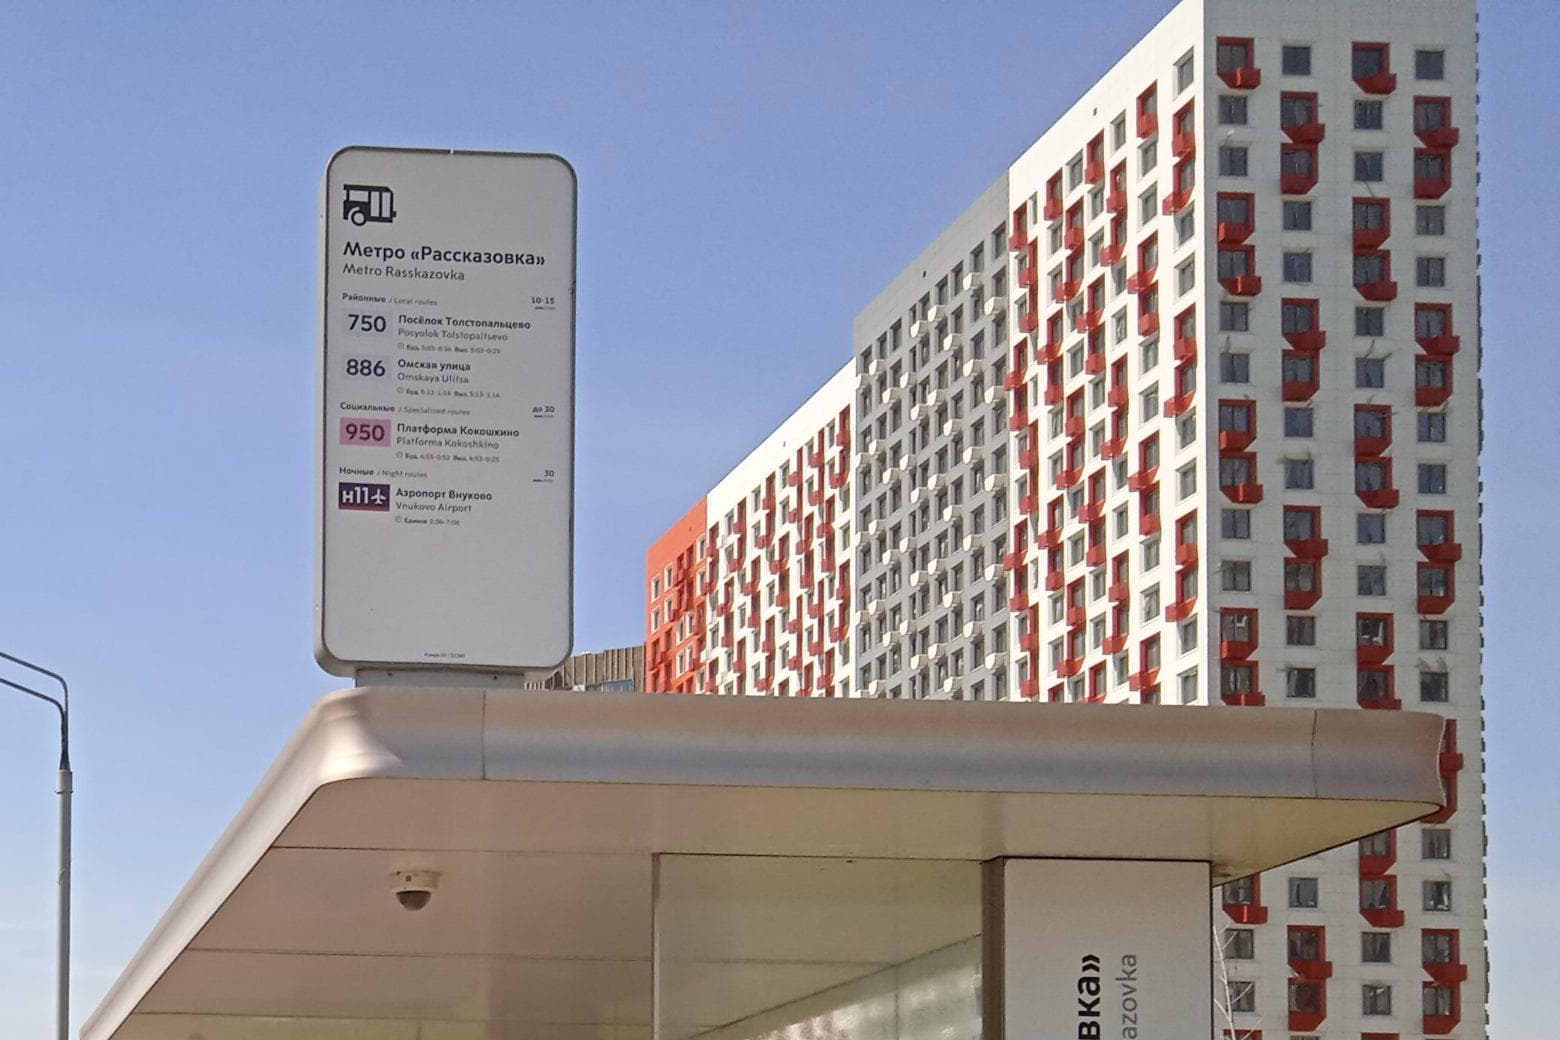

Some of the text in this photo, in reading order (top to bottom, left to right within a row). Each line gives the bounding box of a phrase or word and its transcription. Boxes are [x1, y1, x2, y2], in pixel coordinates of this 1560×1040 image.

[342, 241, 545, 266] Метро «Рассказовка»
[342, 264, 465, 281] Metro Rasskazovka
[342, 292, 386, 303] Районные
[348, 314, 386, 333] 750
[398, 314, 531, 330] Посёлок Толстопальцево
[398, 328, 439, 339] Posyolok
[346, 358, 386, 377] 886
[398, 359, 471, 372] Омская улица
[398, 372, 470, 384] Omskaya Ulitsa
[340, 401, 395, 414] Социальные
[346, 422, 385, 442] 950
[396, 423, 520, 438] Платформа Кокошкино
[396, 436, 499, 450] Platforma Kokoshkino
[339, 466, 374, 476] Ночные
[544, 470, 555, 478] 30
[396, 488, 493, 501] Аэропорт Внуково
[396, 502, 472, 514] Vnukovo Airport
